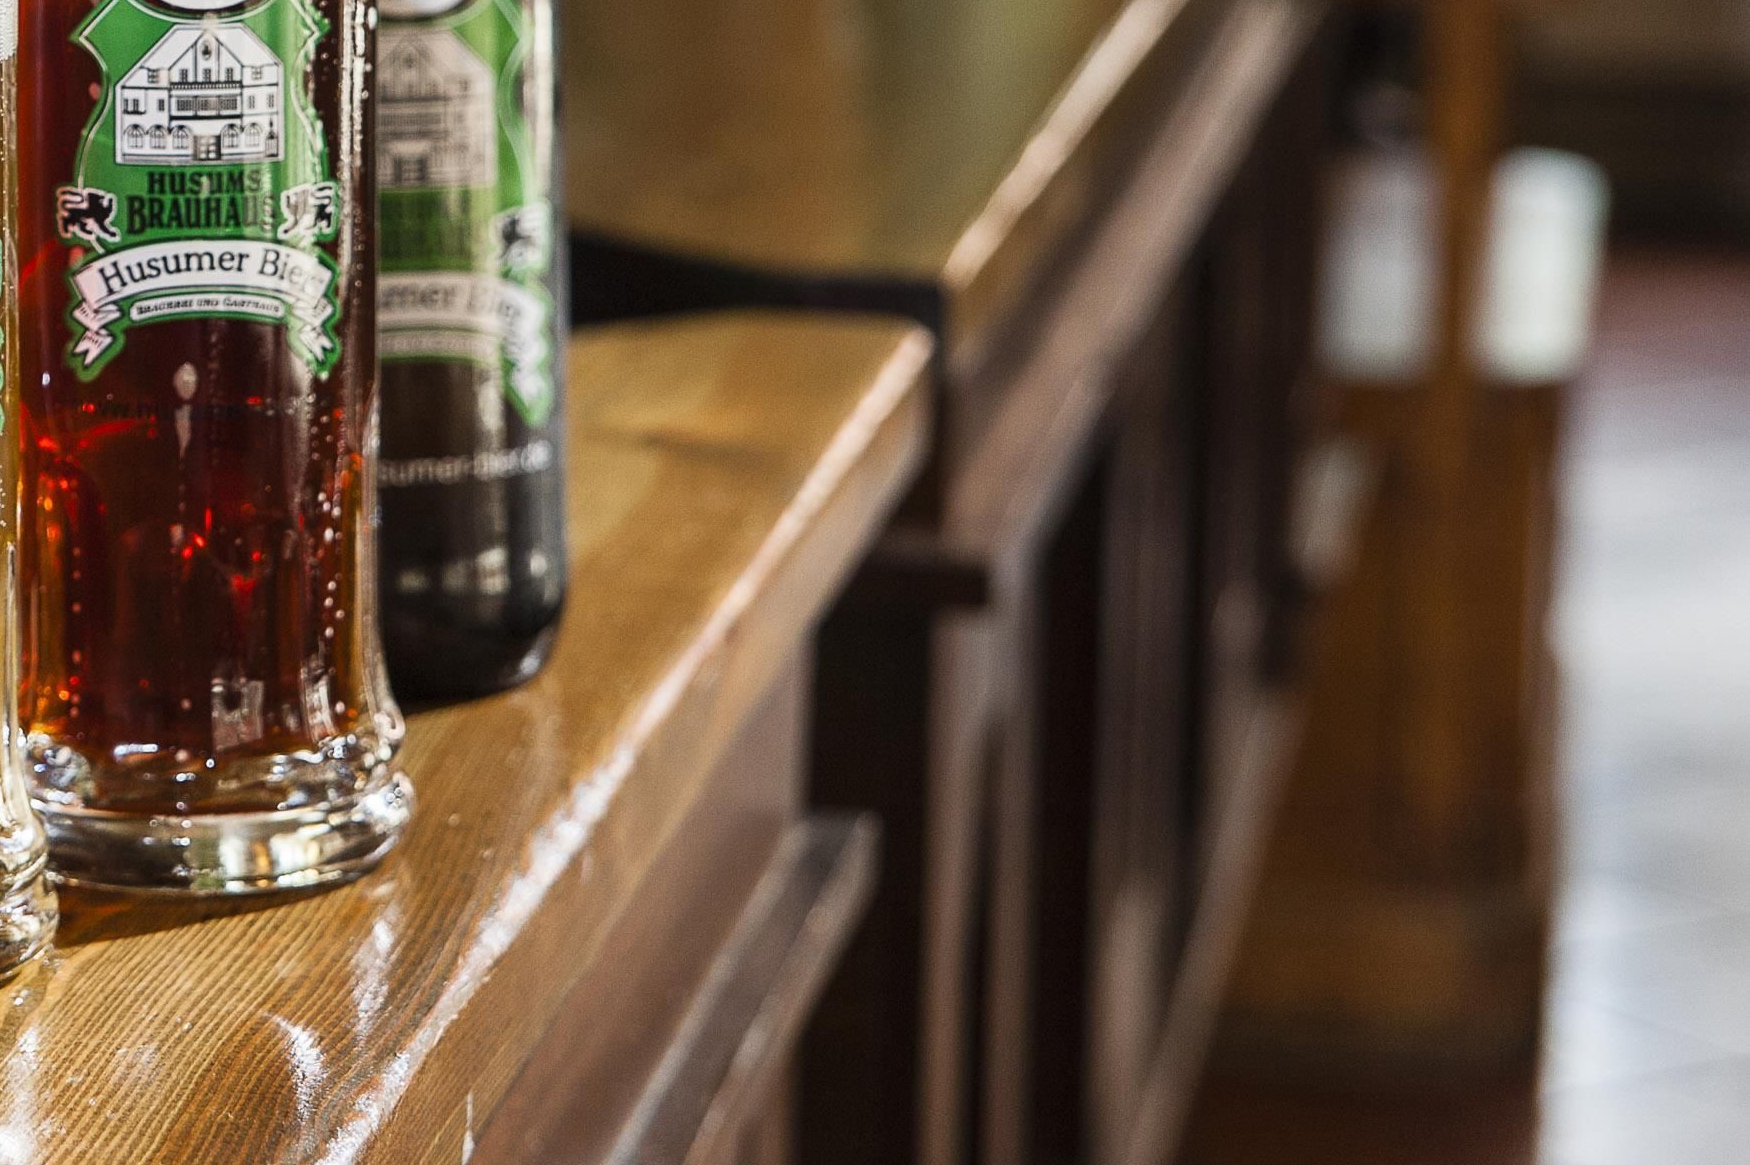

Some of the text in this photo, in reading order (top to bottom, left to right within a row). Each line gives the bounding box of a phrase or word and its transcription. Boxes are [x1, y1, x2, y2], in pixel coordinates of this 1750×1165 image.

[146, 170, 263, 195] HUSUMS
[125, 193, 276, 235] BRAUHAUS
[98, 250, 250, 295] Husumer
